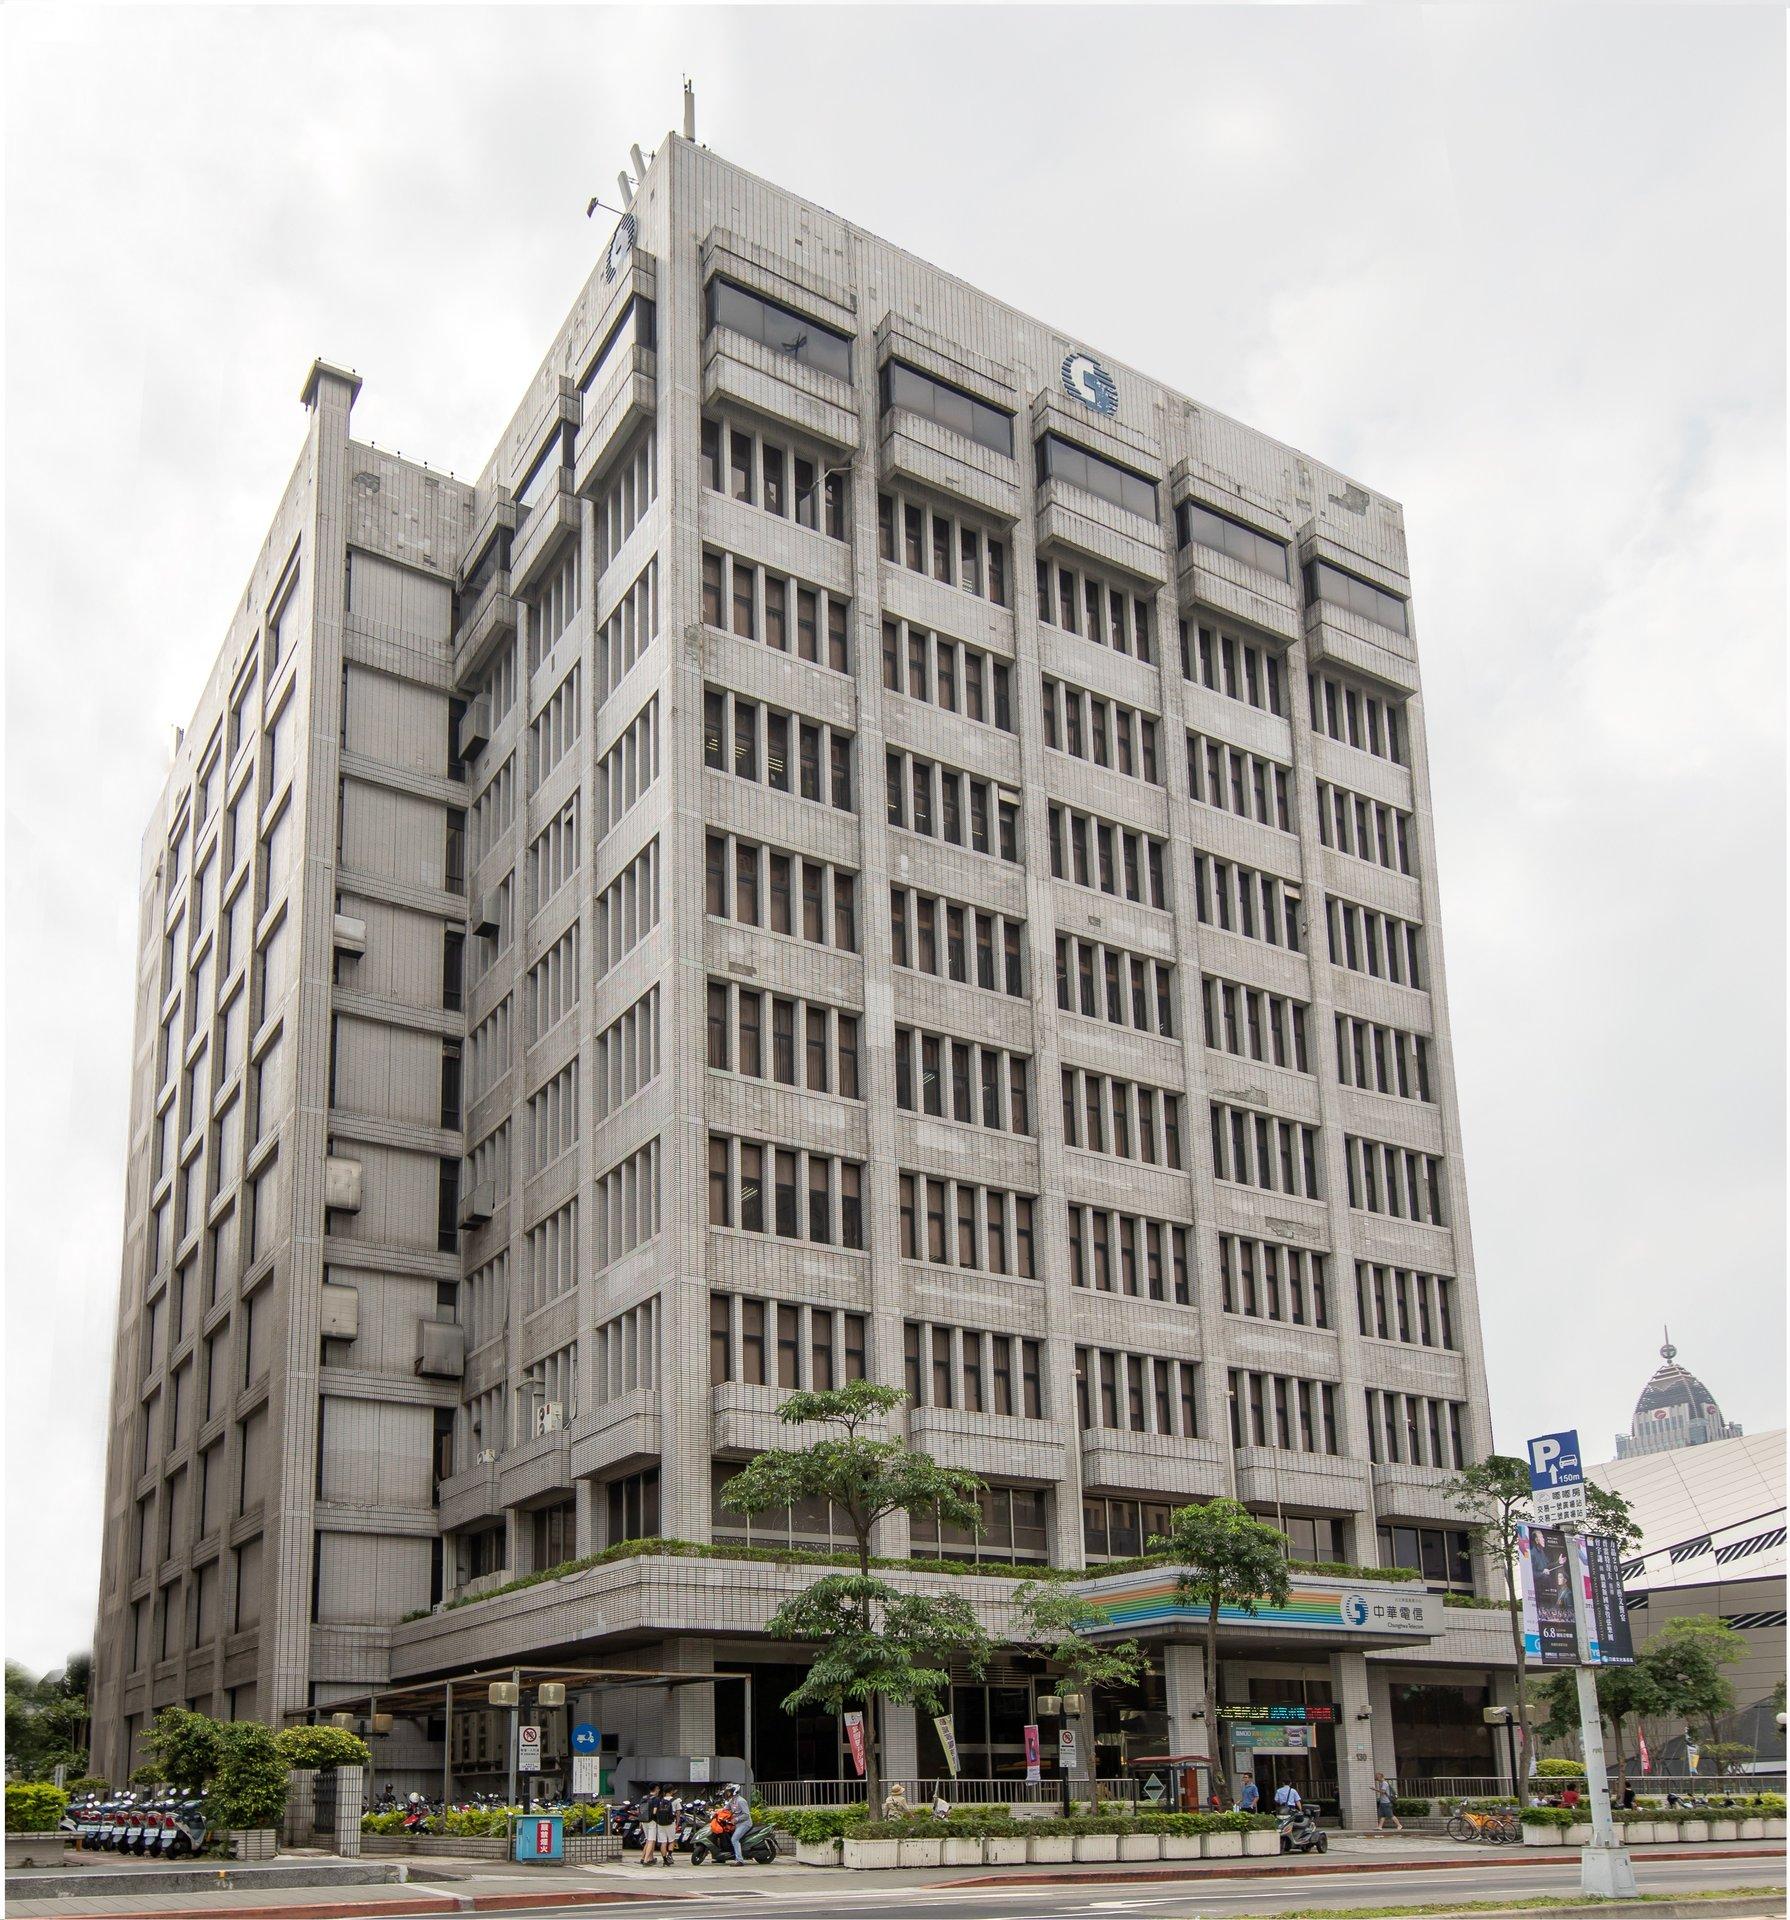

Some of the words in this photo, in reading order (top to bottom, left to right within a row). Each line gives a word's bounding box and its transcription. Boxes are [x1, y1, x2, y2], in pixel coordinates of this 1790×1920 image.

[1532, 1439, 1561, 1474] P
[1558, 1473, 1581, 1483] 150m
[1373, 1604, 1424, 1621] 中華電信
[1543, 1627, 1556, 1638] 6.8
